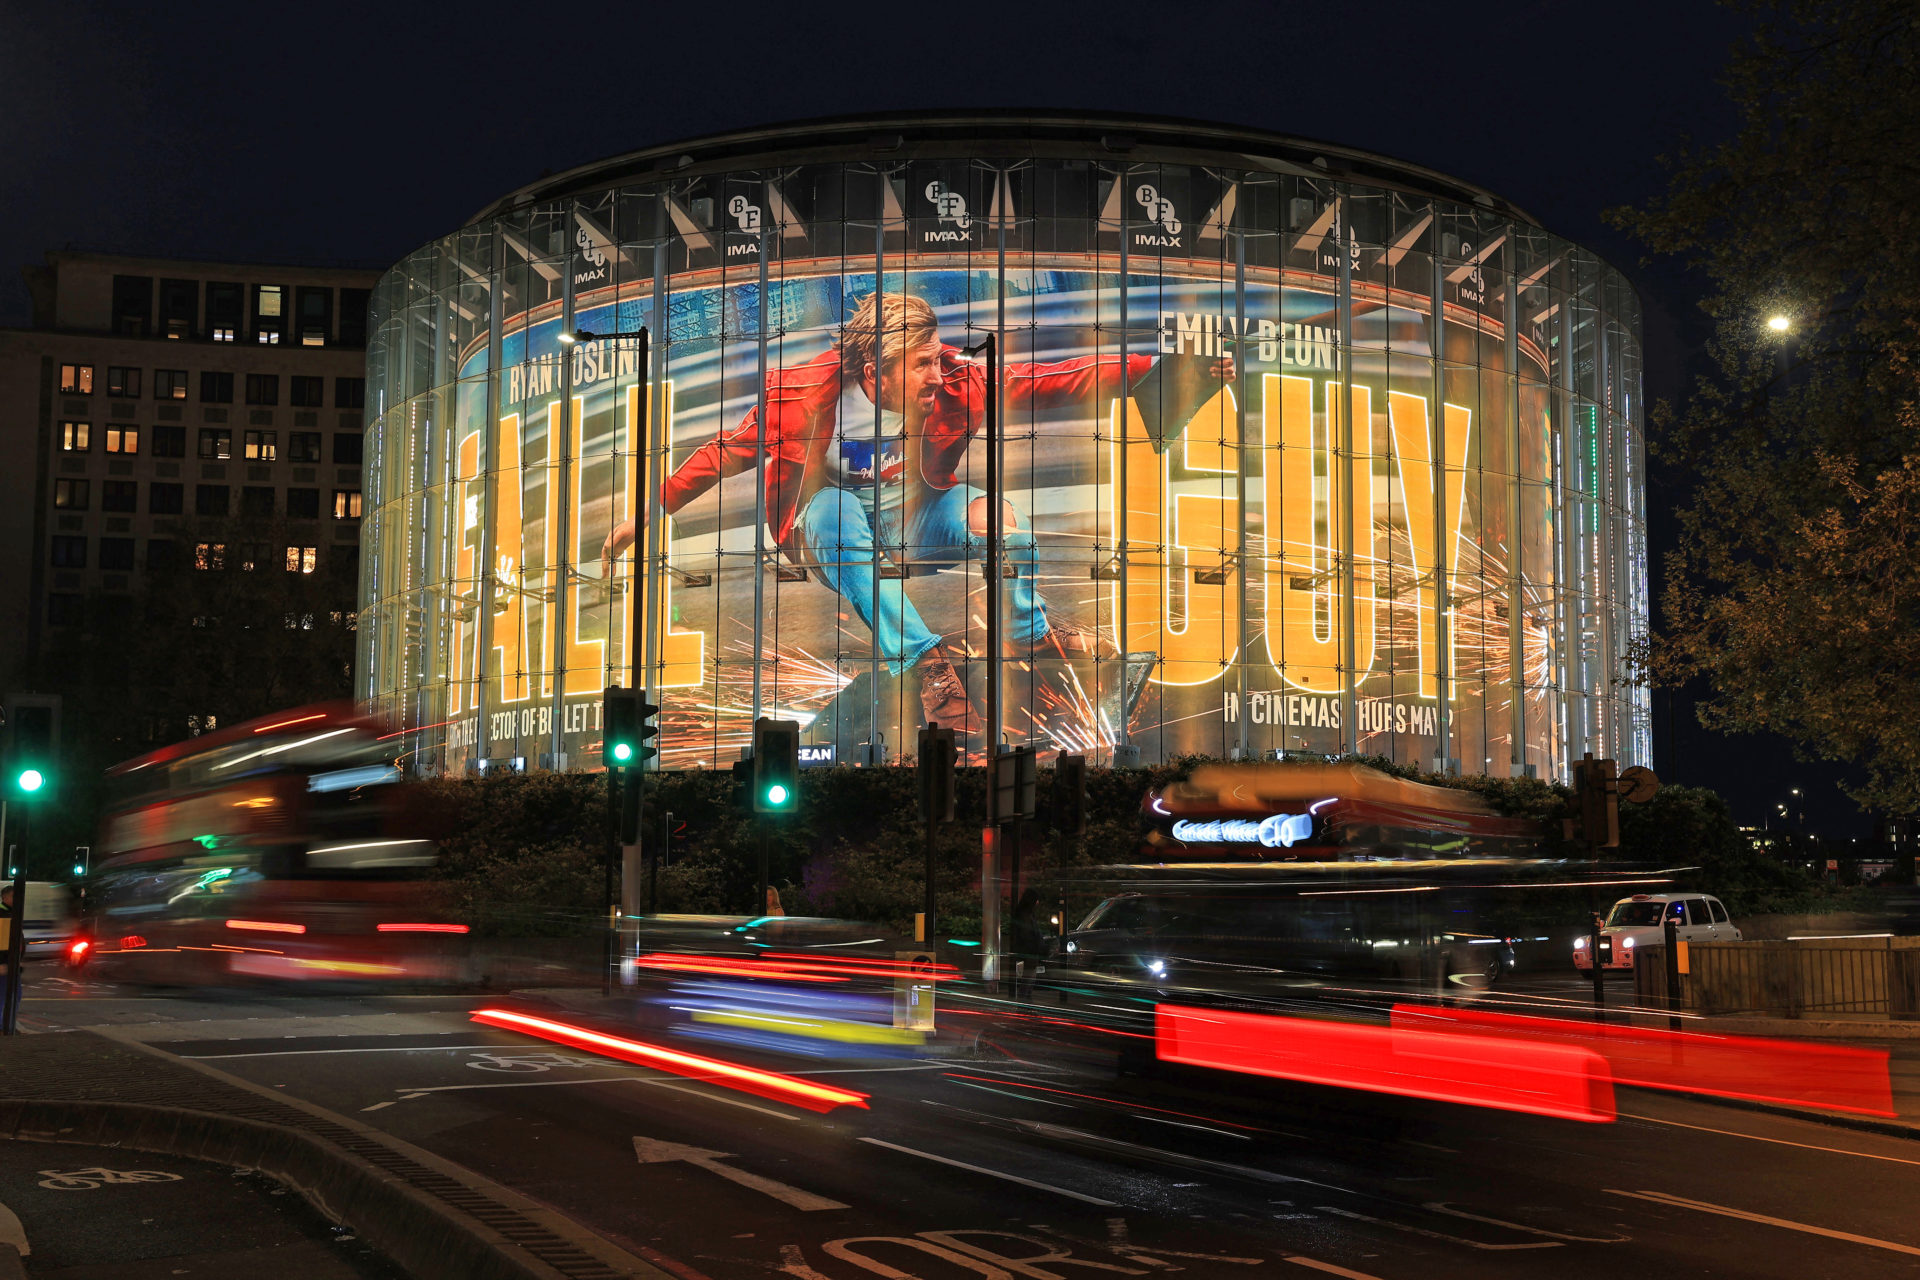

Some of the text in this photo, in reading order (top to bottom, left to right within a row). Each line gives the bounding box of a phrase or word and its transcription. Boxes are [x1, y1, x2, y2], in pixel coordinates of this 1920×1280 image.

[925, 230, 972, 241] IMAX
[1135, 235, 1182, 248] IMAX
[1323, 255, 1361, 271] IMX
[574, 267, 605, 285] IMAX
[1461, 287, 1485, 305] IMAX
[510, 352, 552, 404] RYAN
[1110, 374, 1473, 700] GUY
[521, 707, 537, 737] OF
[1251, 693, 1343, 729] CINEMAS
[1355, 700, 1407, 734] HURS
